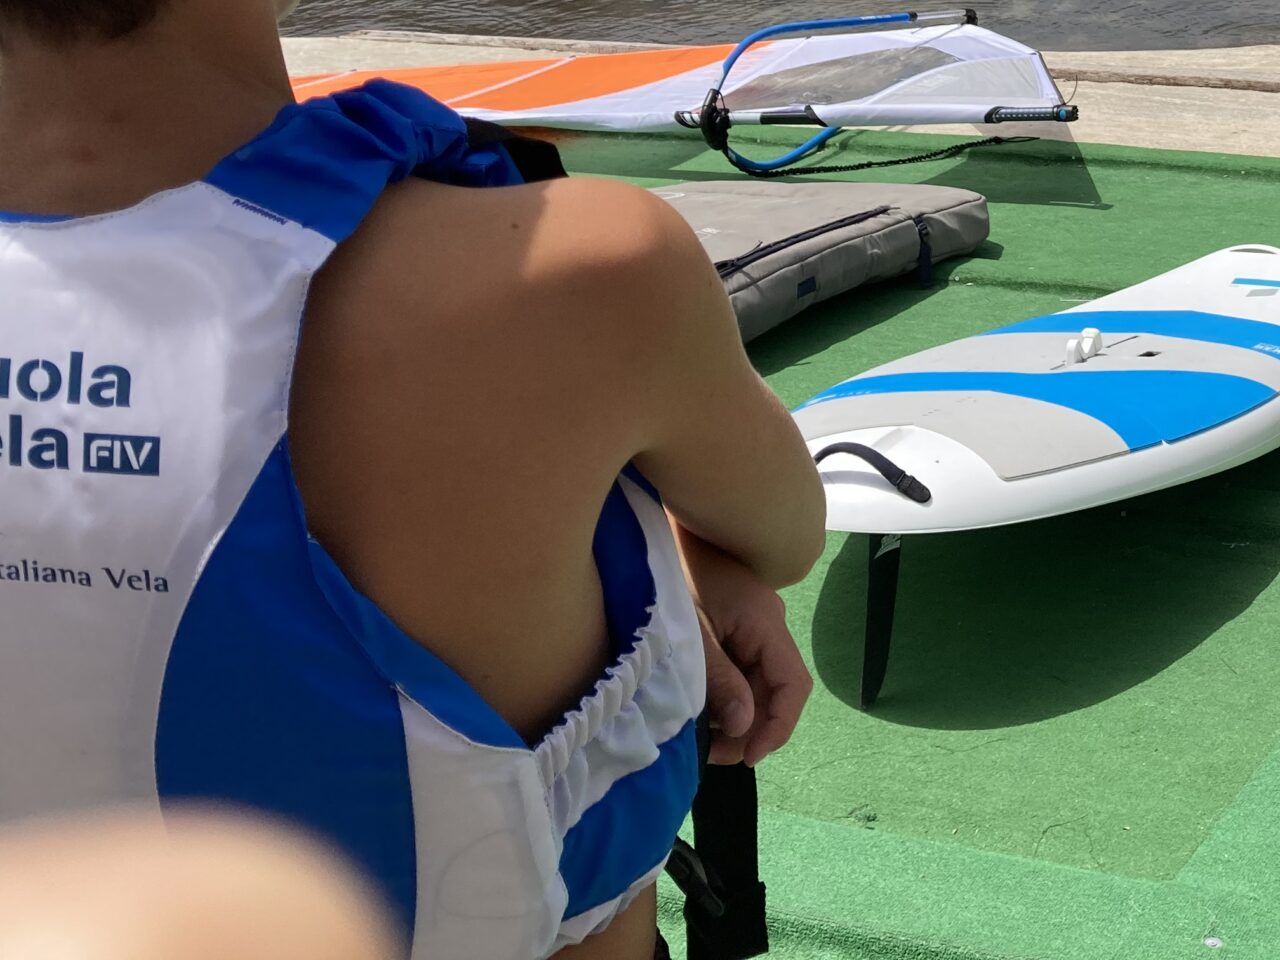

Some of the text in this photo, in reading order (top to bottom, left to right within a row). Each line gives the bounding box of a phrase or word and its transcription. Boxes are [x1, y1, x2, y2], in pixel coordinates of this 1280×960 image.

[0, 414, 154, 471] la FIV
[102, 567, 169, 592] Vela
